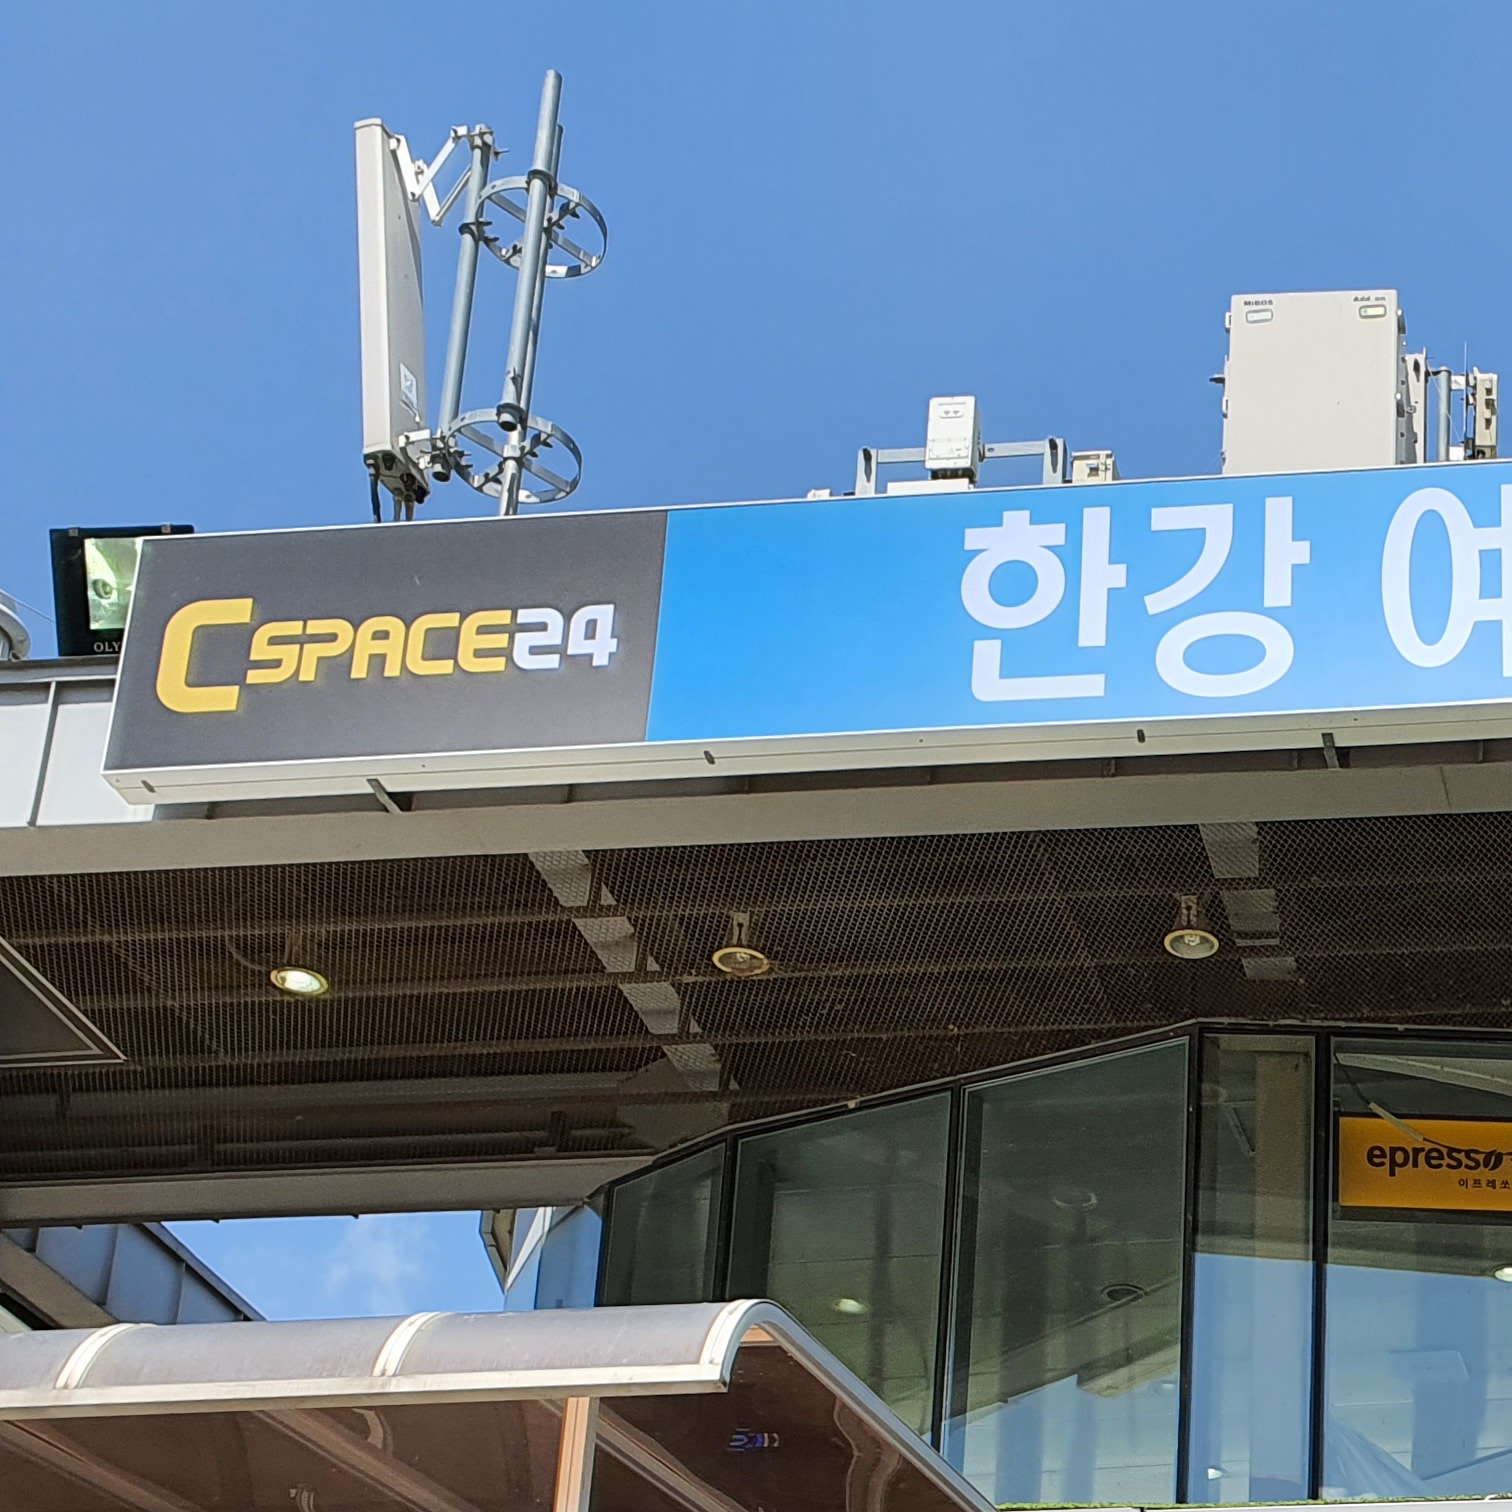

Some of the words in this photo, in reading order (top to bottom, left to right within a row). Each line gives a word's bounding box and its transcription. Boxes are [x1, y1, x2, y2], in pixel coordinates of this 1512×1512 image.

[961, 496, 1310, 702] 한강
[1367, 1144, 1504, 1177] epresso
[1458, 1177, 1511, 1190] 이프레쏘
